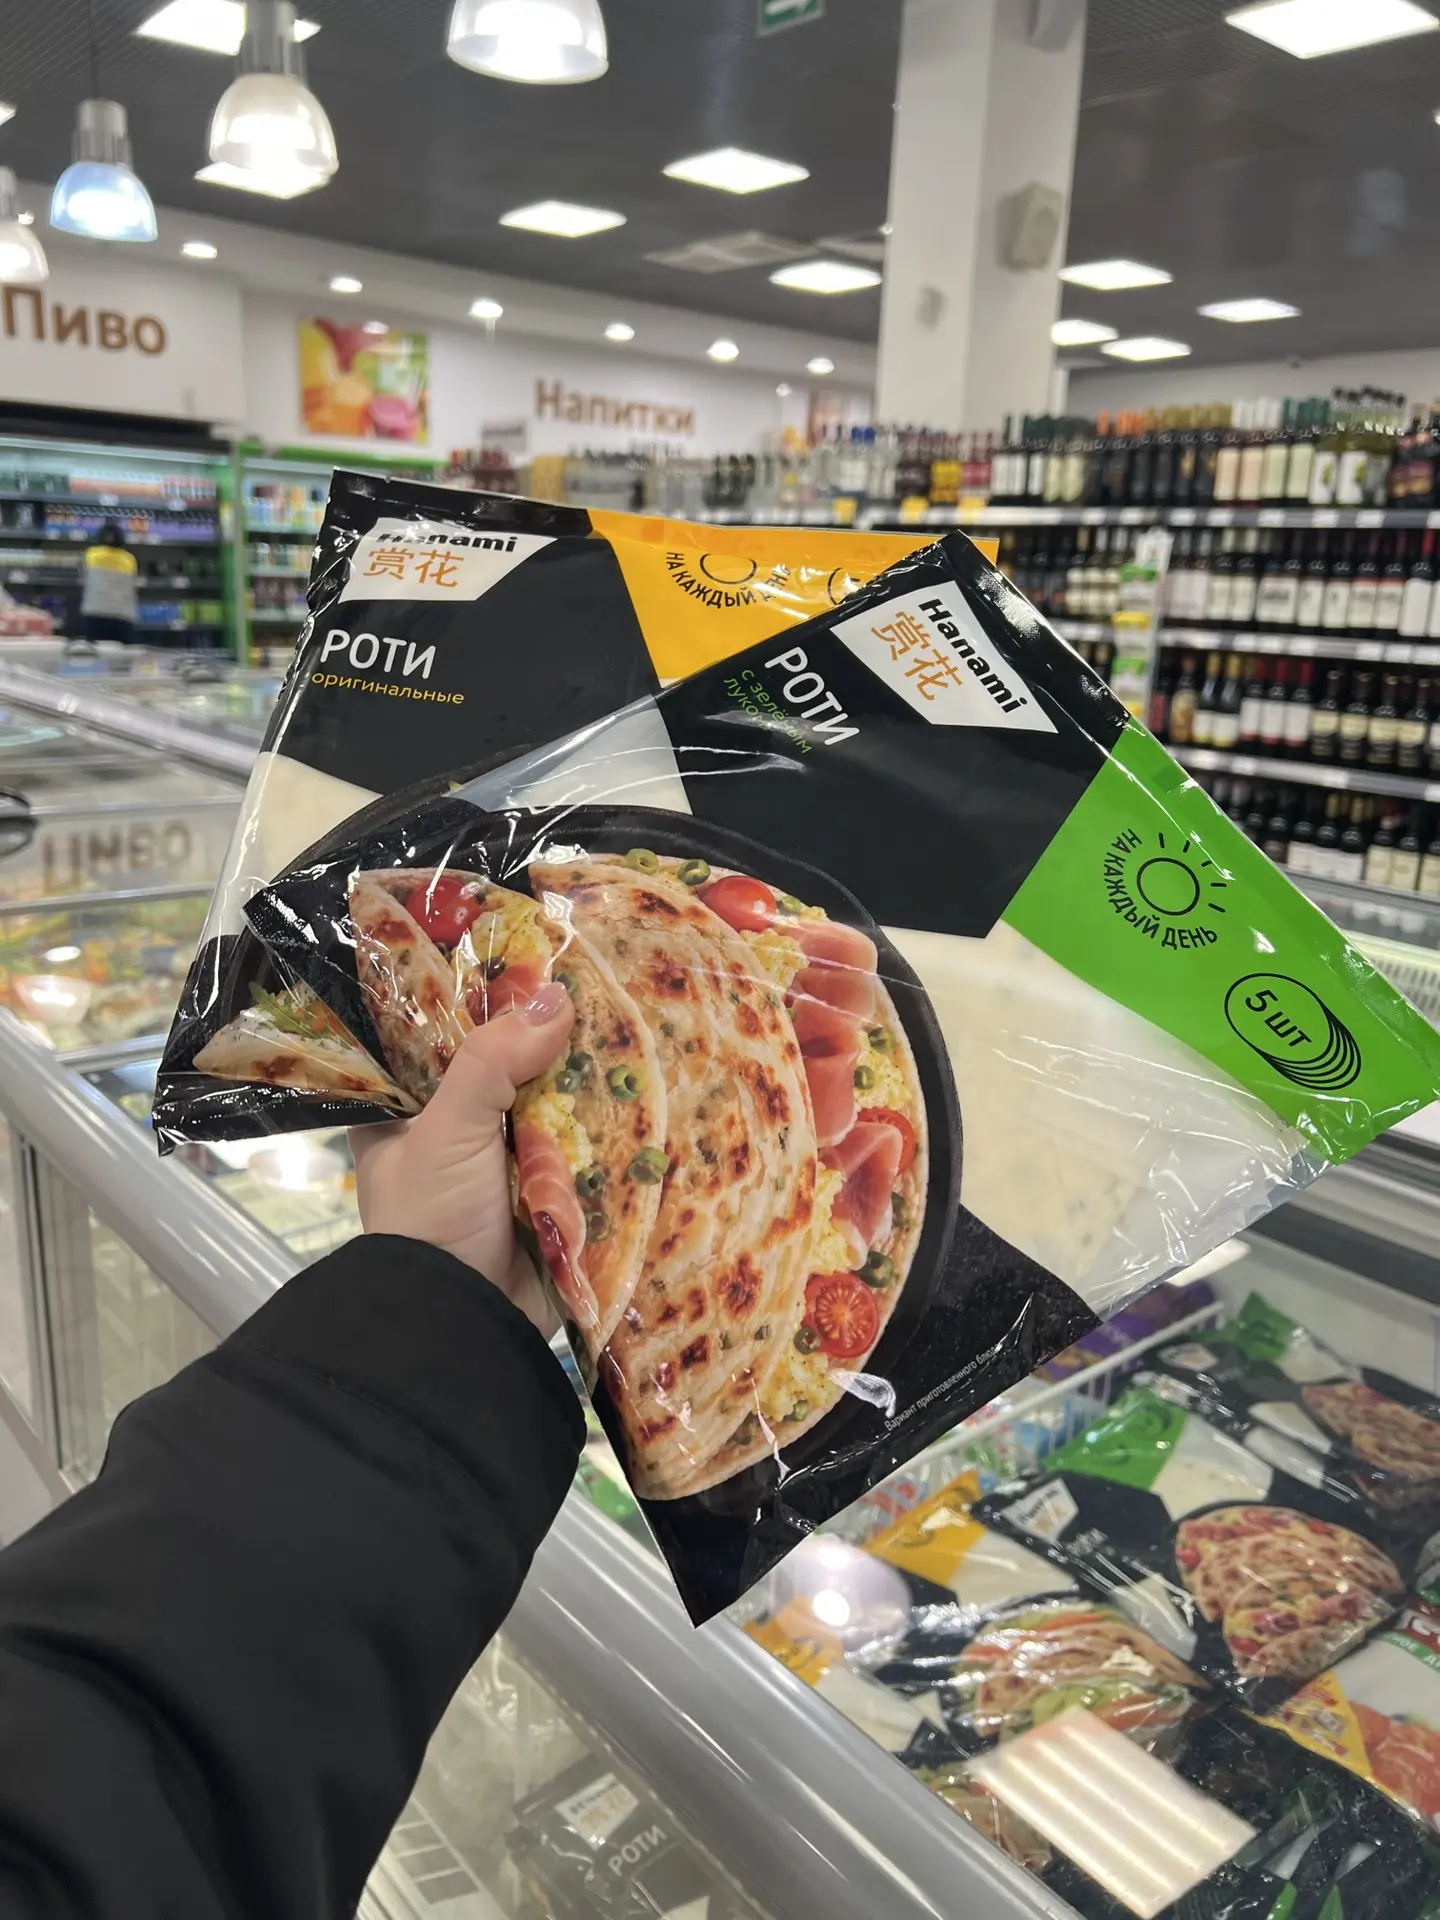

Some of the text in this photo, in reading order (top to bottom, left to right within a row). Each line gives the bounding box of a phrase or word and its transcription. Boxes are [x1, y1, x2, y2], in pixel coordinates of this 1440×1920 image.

[3, 285, 168, 355] Пиво
[534, 376, 696, 435] Напитки
[363, 547, 464, 588] 赏花
[666, 552, 685, 570] НА
[672, 570, 757, 609] КАЖДЫЙ
[320, 629, 437, 680] РОТИ
[870, 611, 963, 700] 赏花
[918, 598, 1028, 714] Hanami
[311, 672, 465, 704] оригинальные
[723, 677, 767, 729] луком
[764, 646, 860, 746] РОТИ
[1104, 828, 1218, 951] НА КАЖДЫЙ ДЕНЬ
[1245, 989, 1278, 1012] 5
[884, 1343, 1002, 1431] Вариант приготовленного блюд
[608, 1825, 667, 1876] РОТИ
